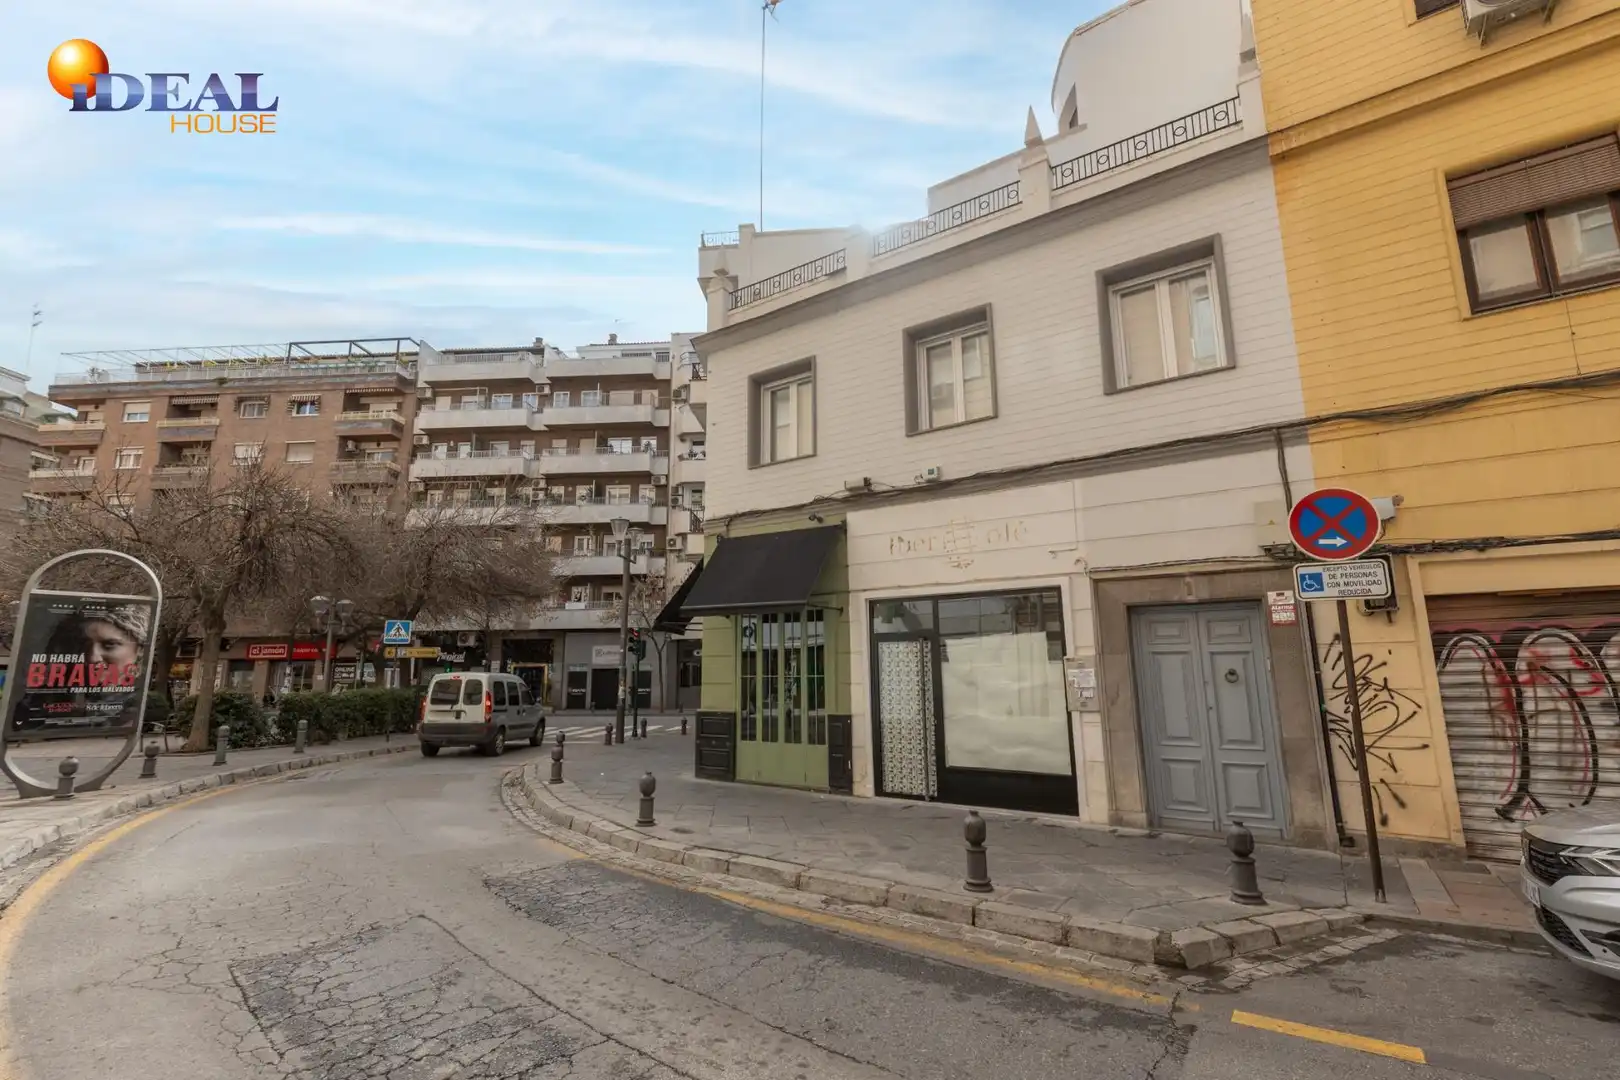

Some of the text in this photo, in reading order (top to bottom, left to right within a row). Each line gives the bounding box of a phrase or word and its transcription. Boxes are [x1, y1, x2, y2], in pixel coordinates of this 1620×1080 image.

[1340, 571, 1378, 579] PERSONAS
[1326, 579, 1382, 589] CON MOVILIDAD
[1338, 588, 1373, 596] REDUCIDA
[31, 653, 86, 663] NO HABRÁ
[27, 663, 138, 688] BRAVAS
